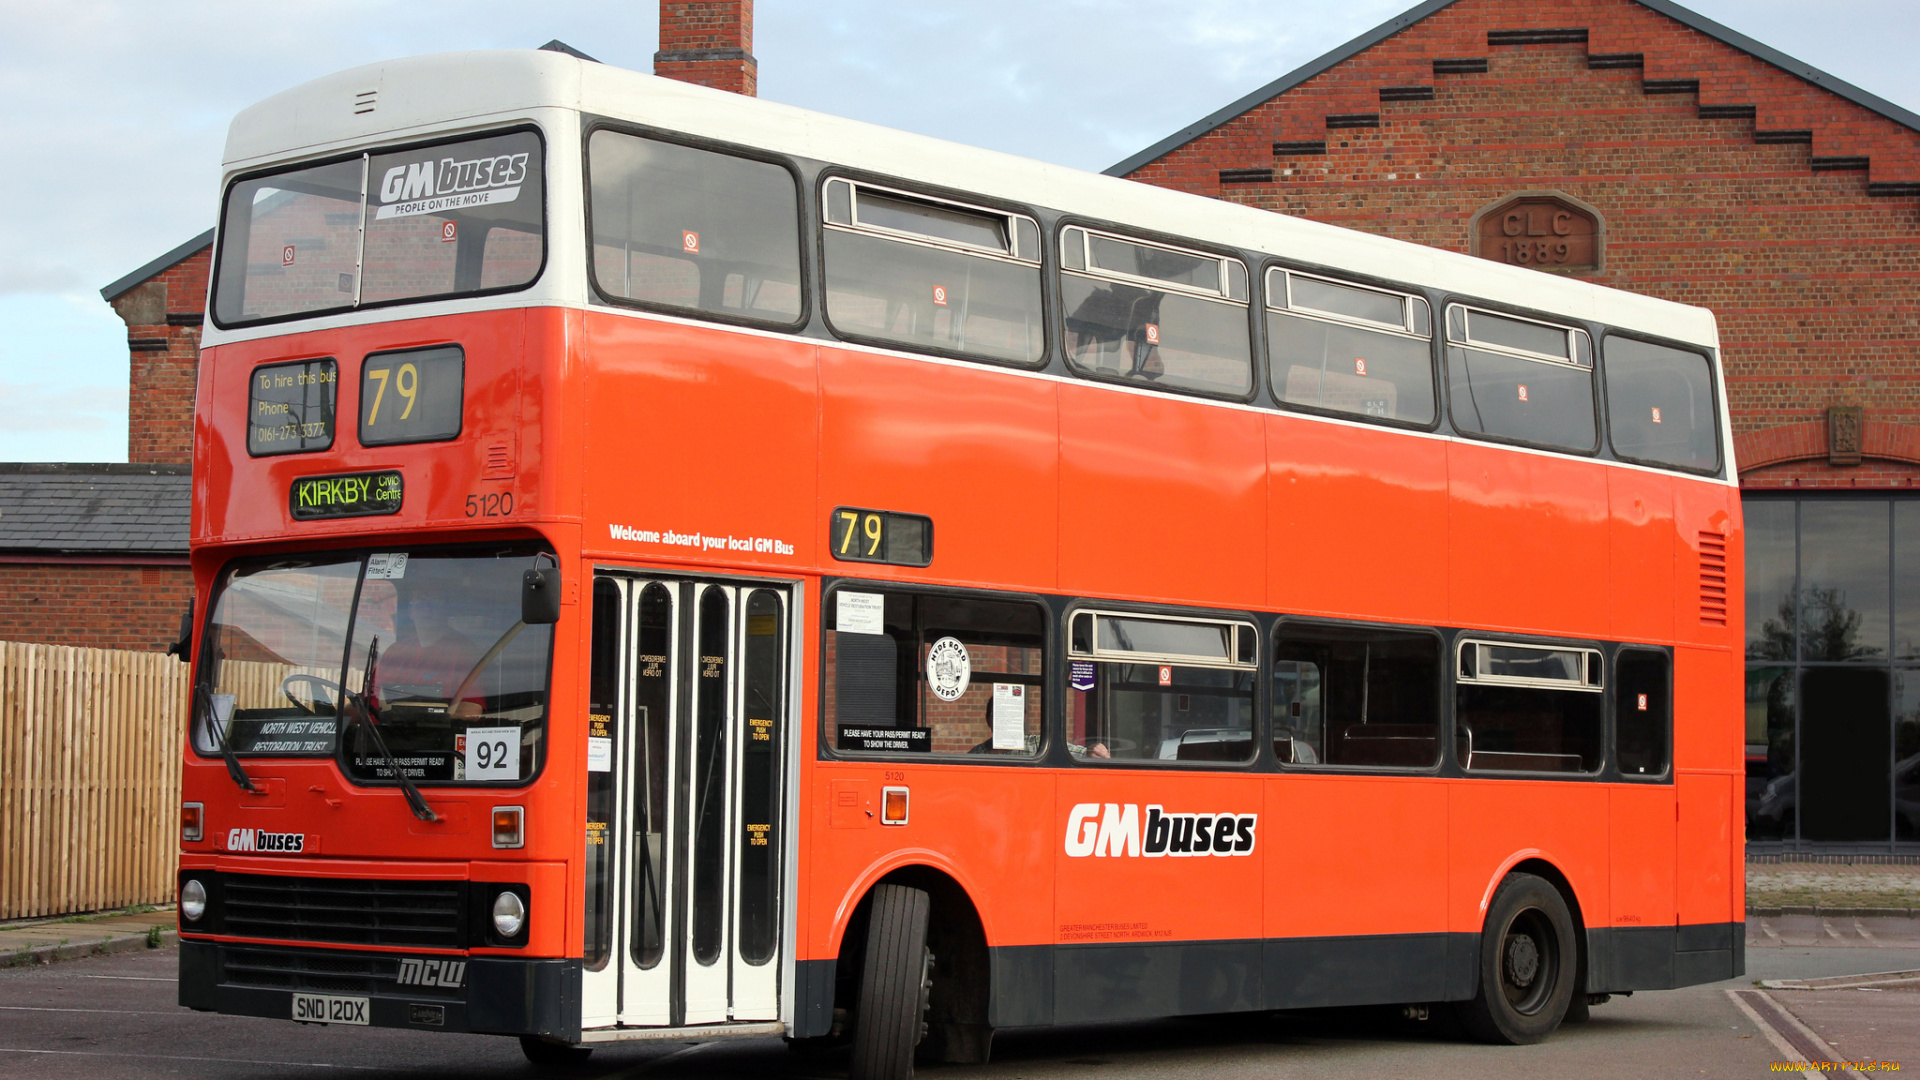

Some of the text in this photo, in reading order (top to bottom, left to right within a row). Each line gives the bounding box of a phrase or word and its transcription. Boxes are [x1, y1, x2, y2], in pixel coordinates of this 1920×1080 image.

[380, 153, 529, 203] GM buses
[395, 193, 490, 214] PEOPLE ON THE MOVE
[1502, 240, 1571, 264] 1889
[260, 369, 336, 389] To hire this bus
[368, 363, 418, 426] 79
[258, 402, 289, 416] Phone
[258, 422, 326, 442] 0161-273 3377
[300, 475, 399, 506] KIRKBY Civic
[376, 488, 401, 501] Centre
[465, 492, 514, 518] 5120
[609, 524, 794, 556] Welcome aboard your local GM Bus
[840, 512, 882, 556] 79
[932, 642, 966, 662] HYDE ROAD
[936, 686, 960, 696] DEPOT
[260, 722, 288, 734] NORTH
[286, 722, 310, 734] WEST
[843, 729, 860, 737] PLEASE
[861, 730, 872, 738] HAVE
[872, 730, 884, 738] YOUR
[912, 731, 926, 739] READY
[252, 741, 328, 751] RESTORATION TRUST
[476, 741, 508, 769] 92
[356, 758, 373, 766] PLSE
[373, 758, 385, 766] HAVE
[428, 758, 445, 766] READY
[885, 771, 905, 781] 5120
[228, 828, 304, 852] GM buses
[1065, 803, 1258, 858] GM buses
[1060, 924, 1082, 932] GREATER
[397, 958, 466, 988] MCW
[298, 998, 364, 1022] SND 120X
